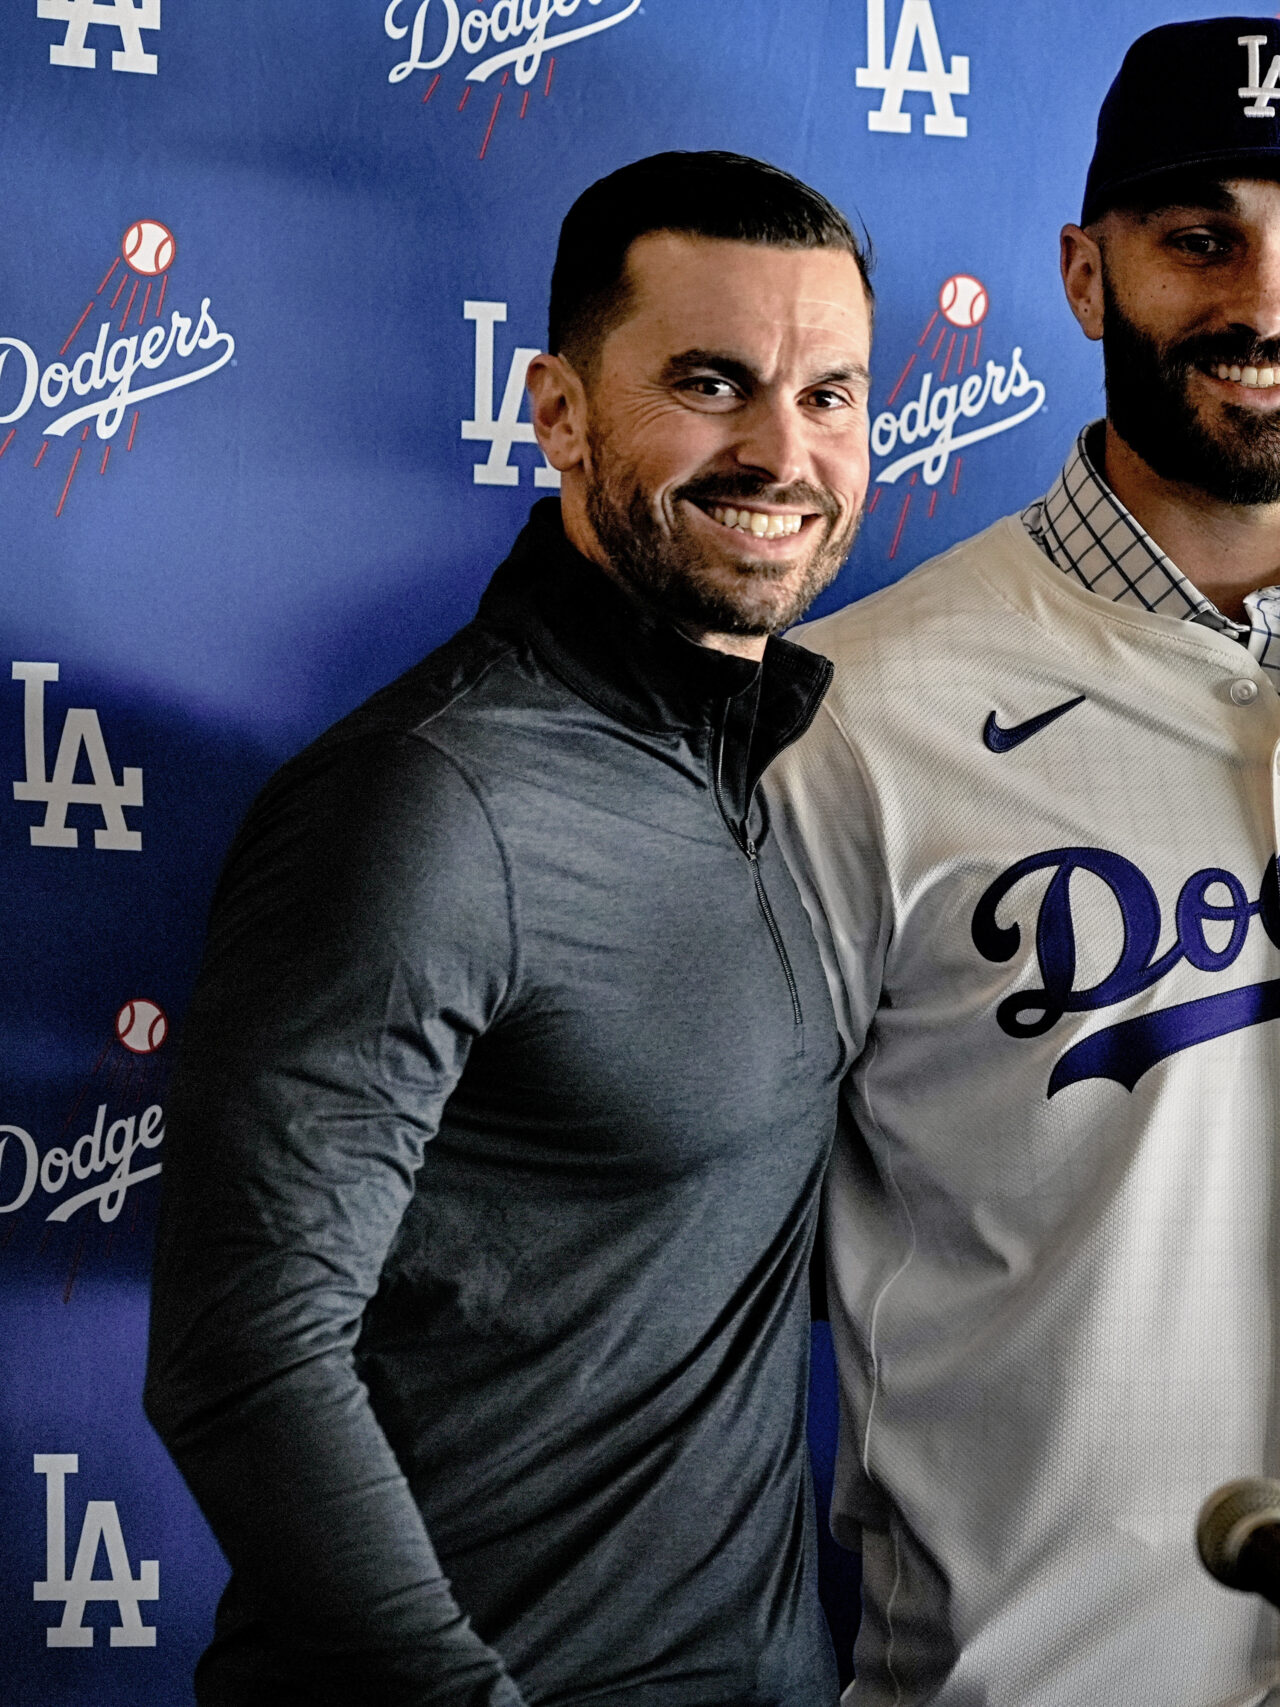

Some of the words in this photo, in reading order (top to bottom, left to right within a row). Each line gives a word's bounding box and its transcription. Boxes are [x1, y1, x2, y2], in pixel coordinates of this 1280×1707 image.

[37, 0, 161, 75] A
[855, 0, 970, 138] LA
[869, 346, 1046, 485] odgers
[12, 661, 143, 852] LA
[33, 1453, 159, 1648] LA
